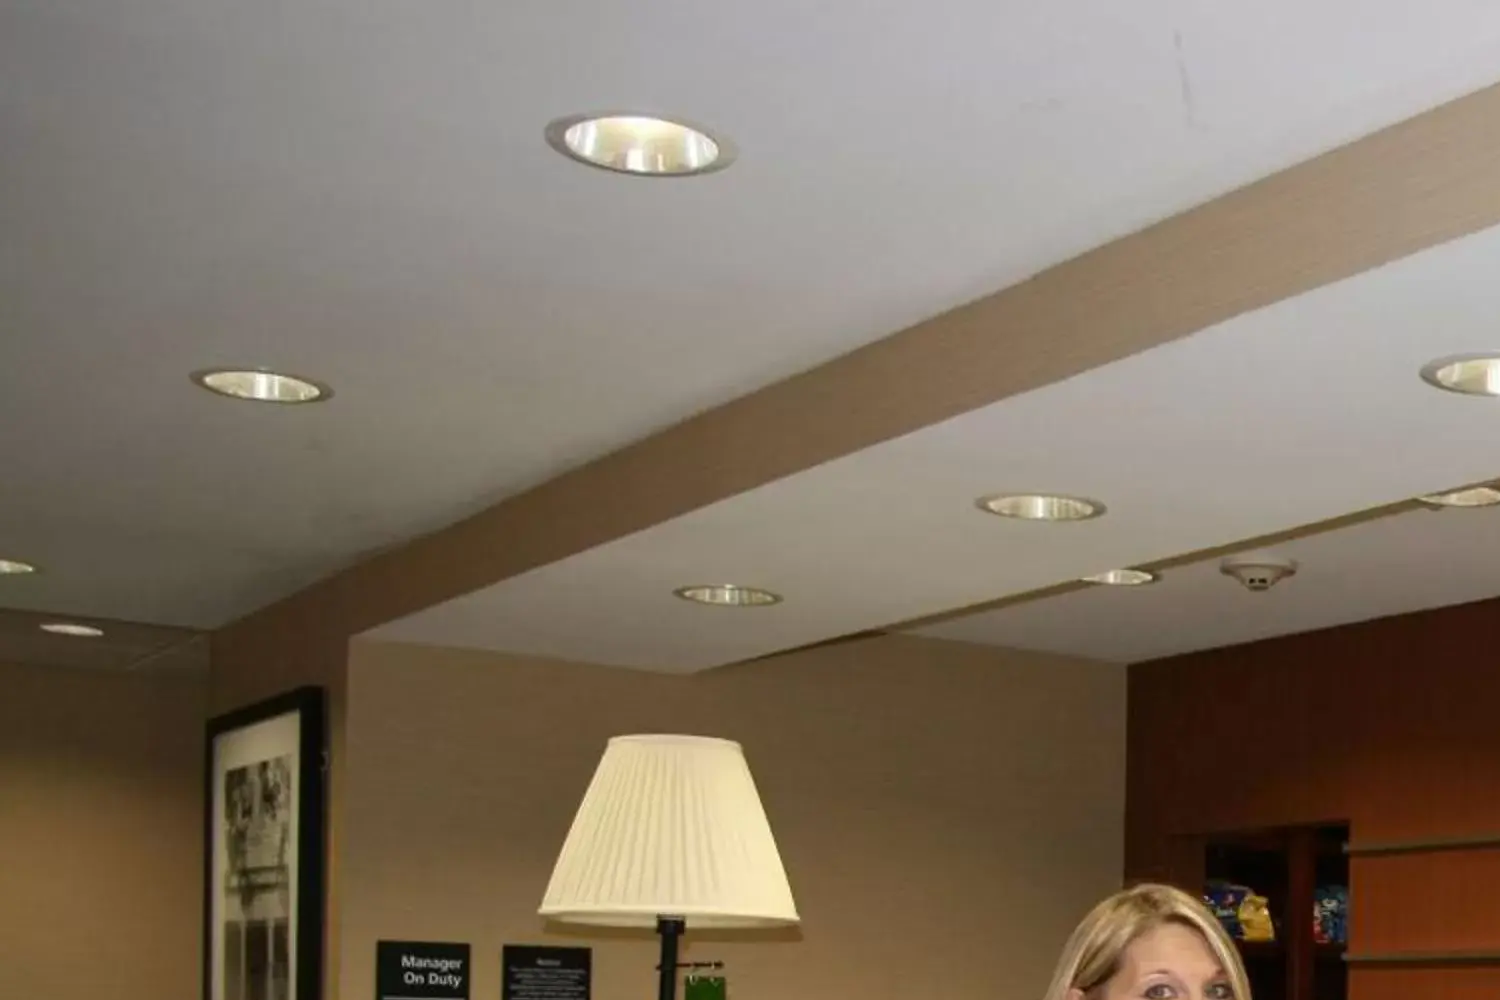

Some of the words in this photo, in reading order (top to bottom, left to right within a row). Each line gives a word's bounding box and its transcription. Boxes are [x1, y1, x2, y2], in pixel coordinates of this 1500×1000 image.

[401, 954, 462, 973] Manager
[403, 971, 425, 985] On
[429, 972, 462, 989] Duty
